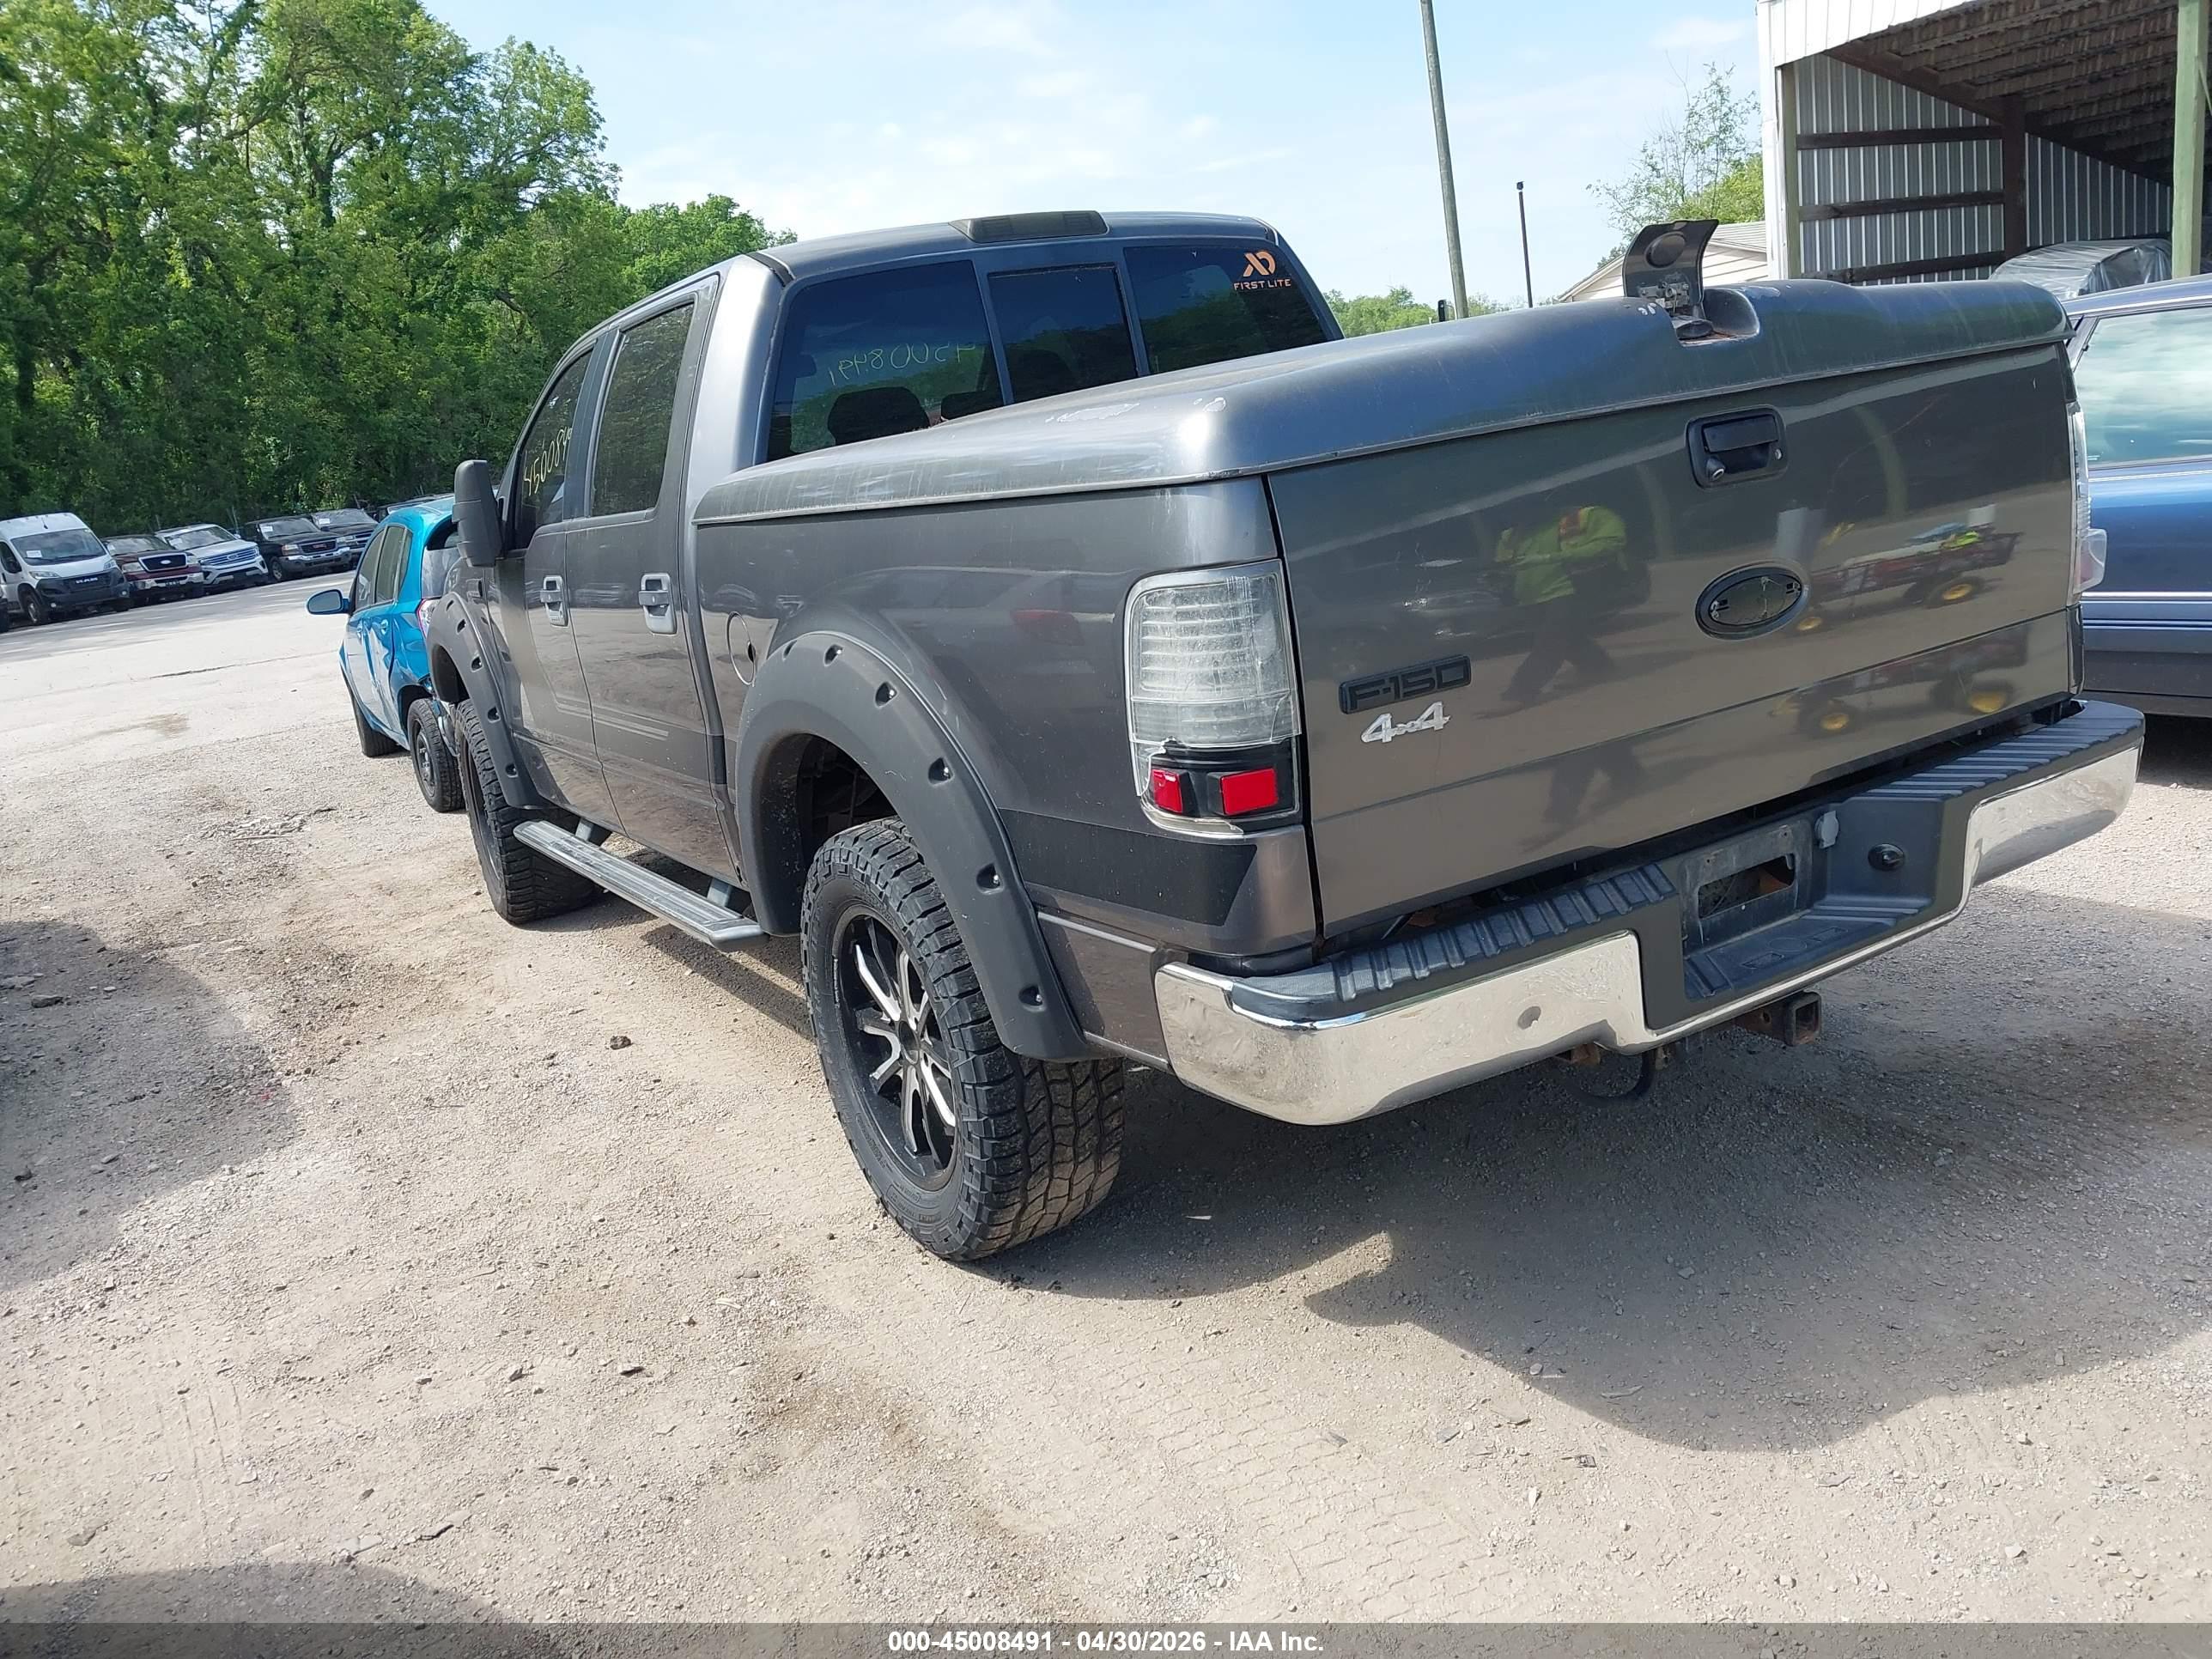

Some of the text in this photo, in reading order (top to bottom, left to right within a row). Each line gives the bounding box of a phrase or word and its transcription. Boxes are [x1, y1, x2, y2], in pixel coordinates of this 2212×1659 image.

[1234, 278, 1291, 291] FIRST LITE
[1347, 660, 1468, 712] F-150
